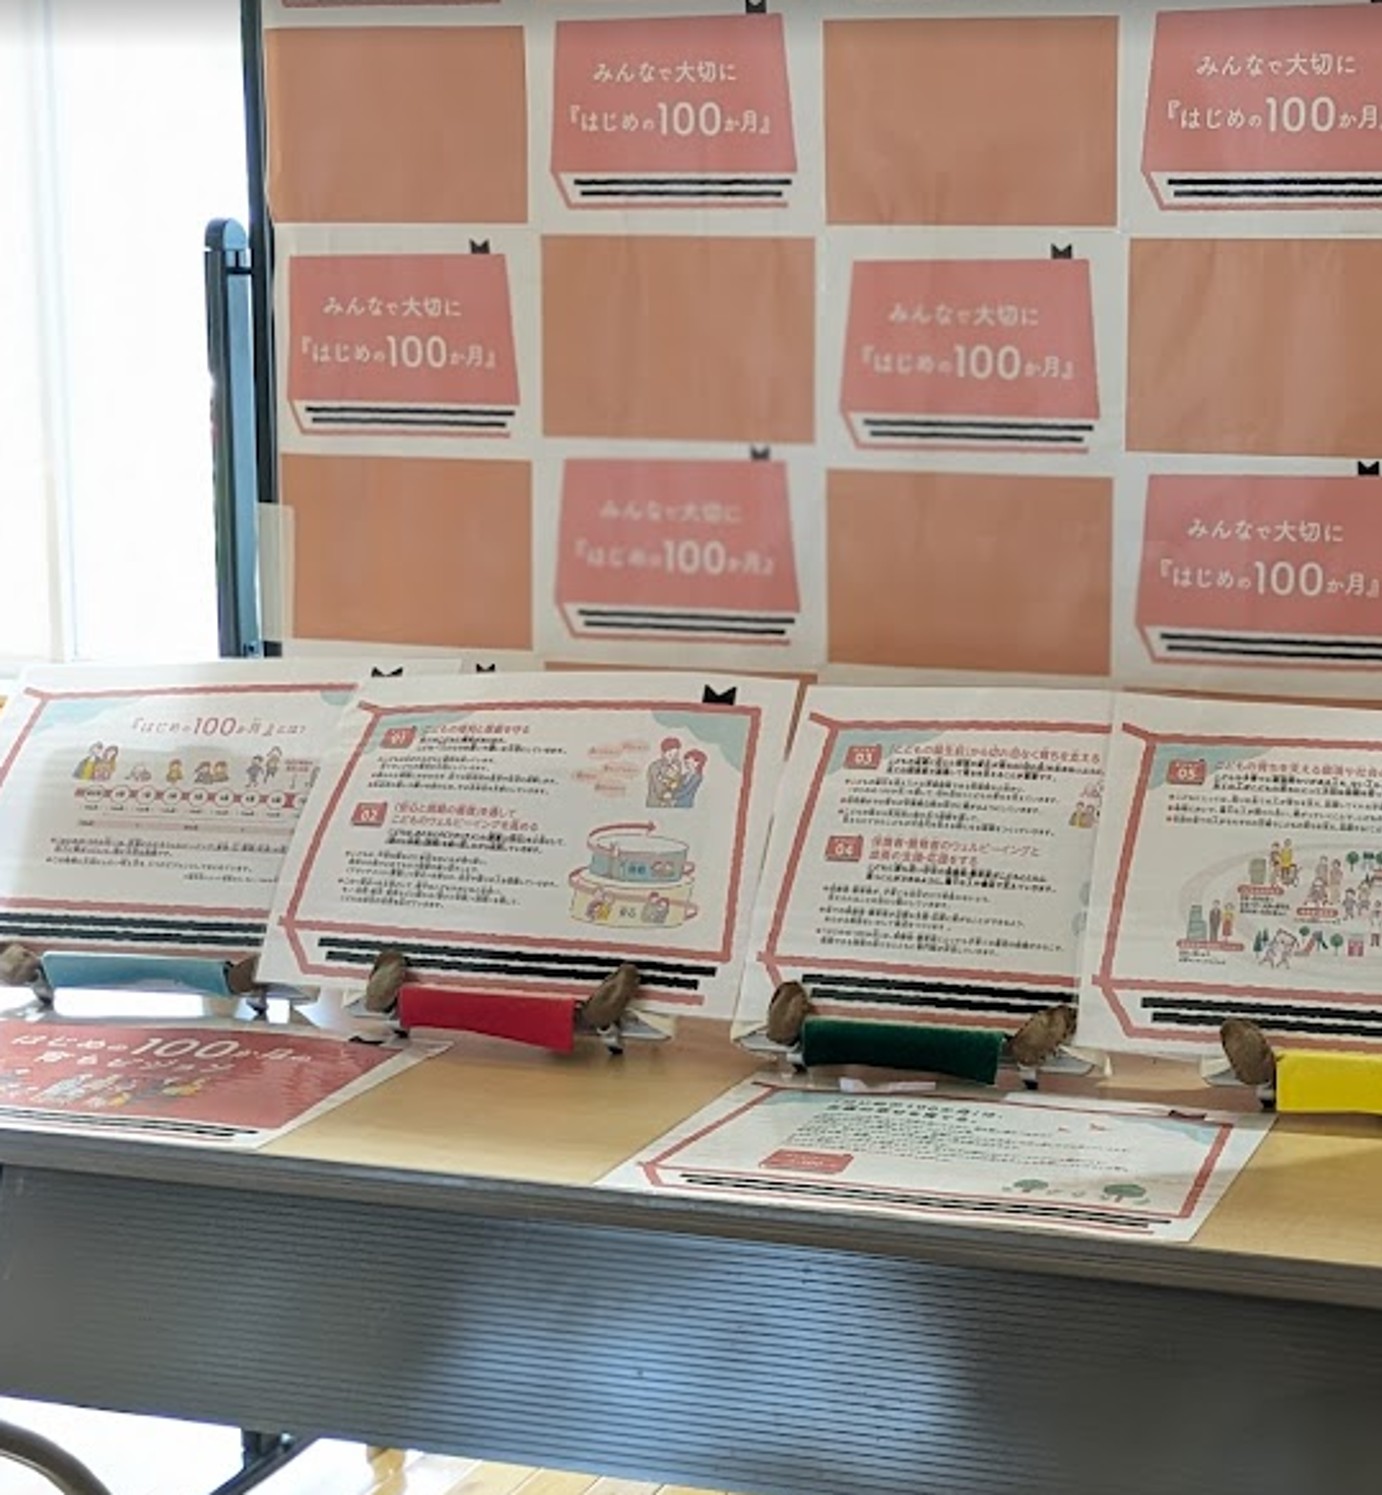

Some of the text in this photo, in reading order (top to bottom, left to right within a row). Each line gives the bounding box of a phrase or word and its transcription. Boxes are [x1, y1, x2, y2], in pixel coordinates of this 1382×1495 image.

[594, 60, 736, 83] みんなで大切に
[1197, 53, 1355, 77] みんなで大切に
[323, 296, 461, 317] みんなで大切に
[889, 303, 1038, 326] みんなで大切に
[1188, 519, 1342, 541] みんなで大切に
